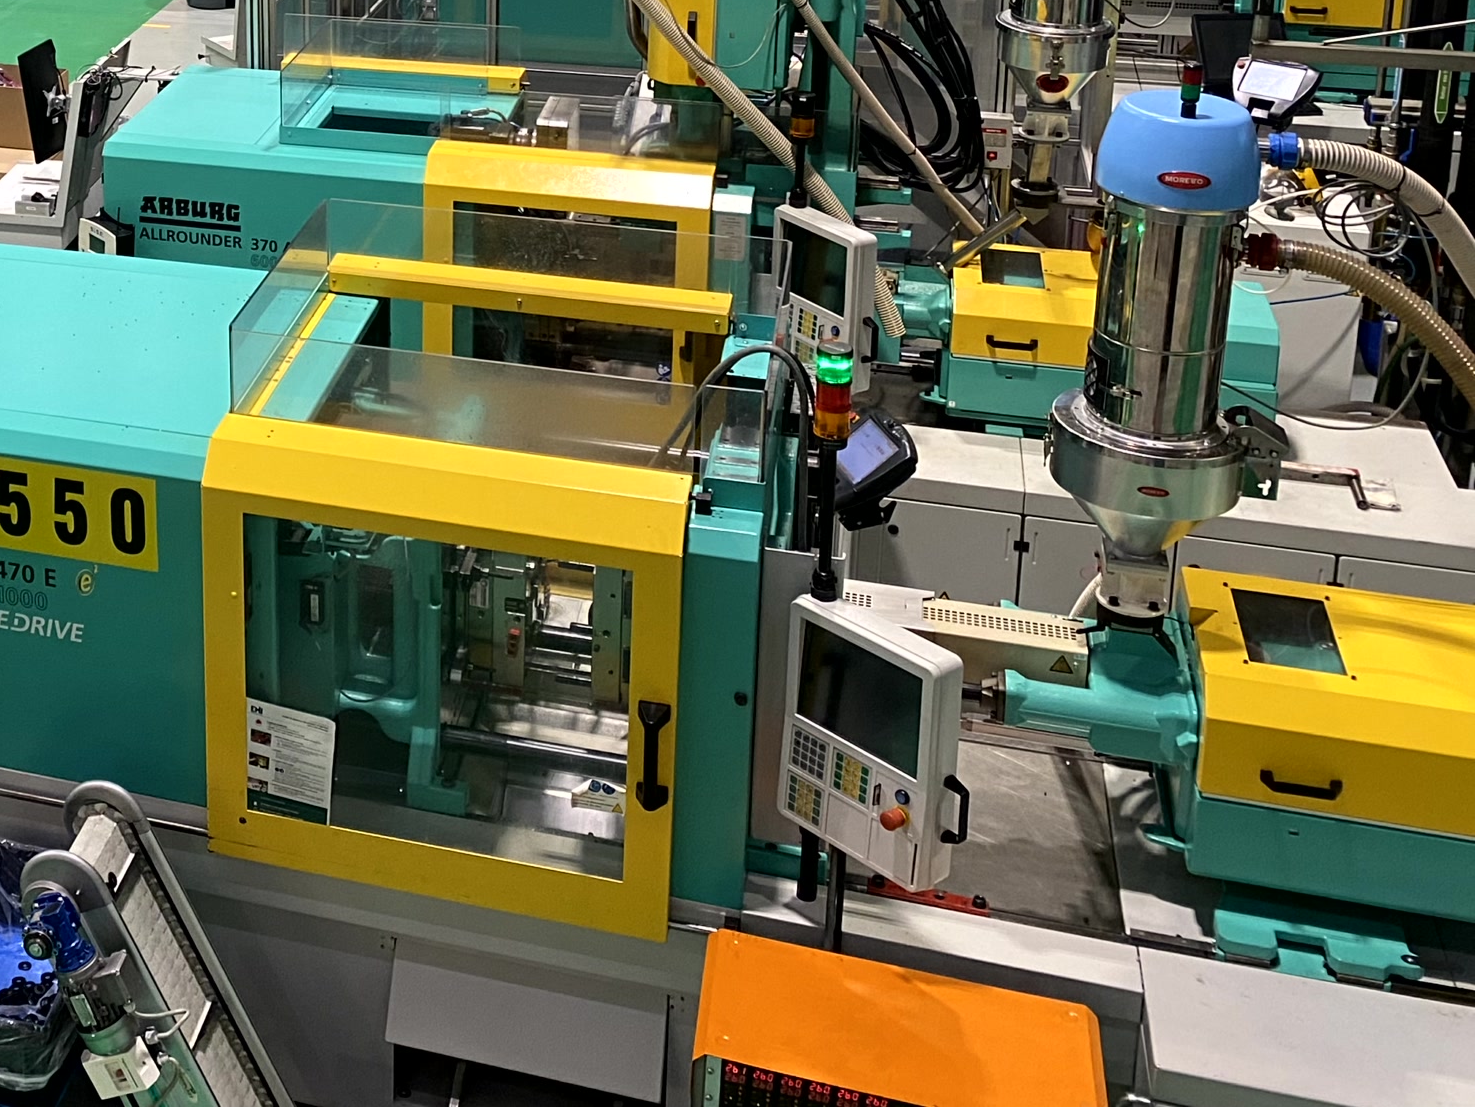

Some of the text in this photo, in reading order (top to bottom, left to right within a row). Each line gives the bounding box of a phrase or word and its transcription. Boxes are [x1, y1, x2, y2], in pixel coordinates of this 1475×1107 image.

[140, 196, 241, 223] ARBURG
[139, 226, 243, 249] ALLROUNDER
[251, 237, 278, 253] 370
[43, 567, 57, 588] E
